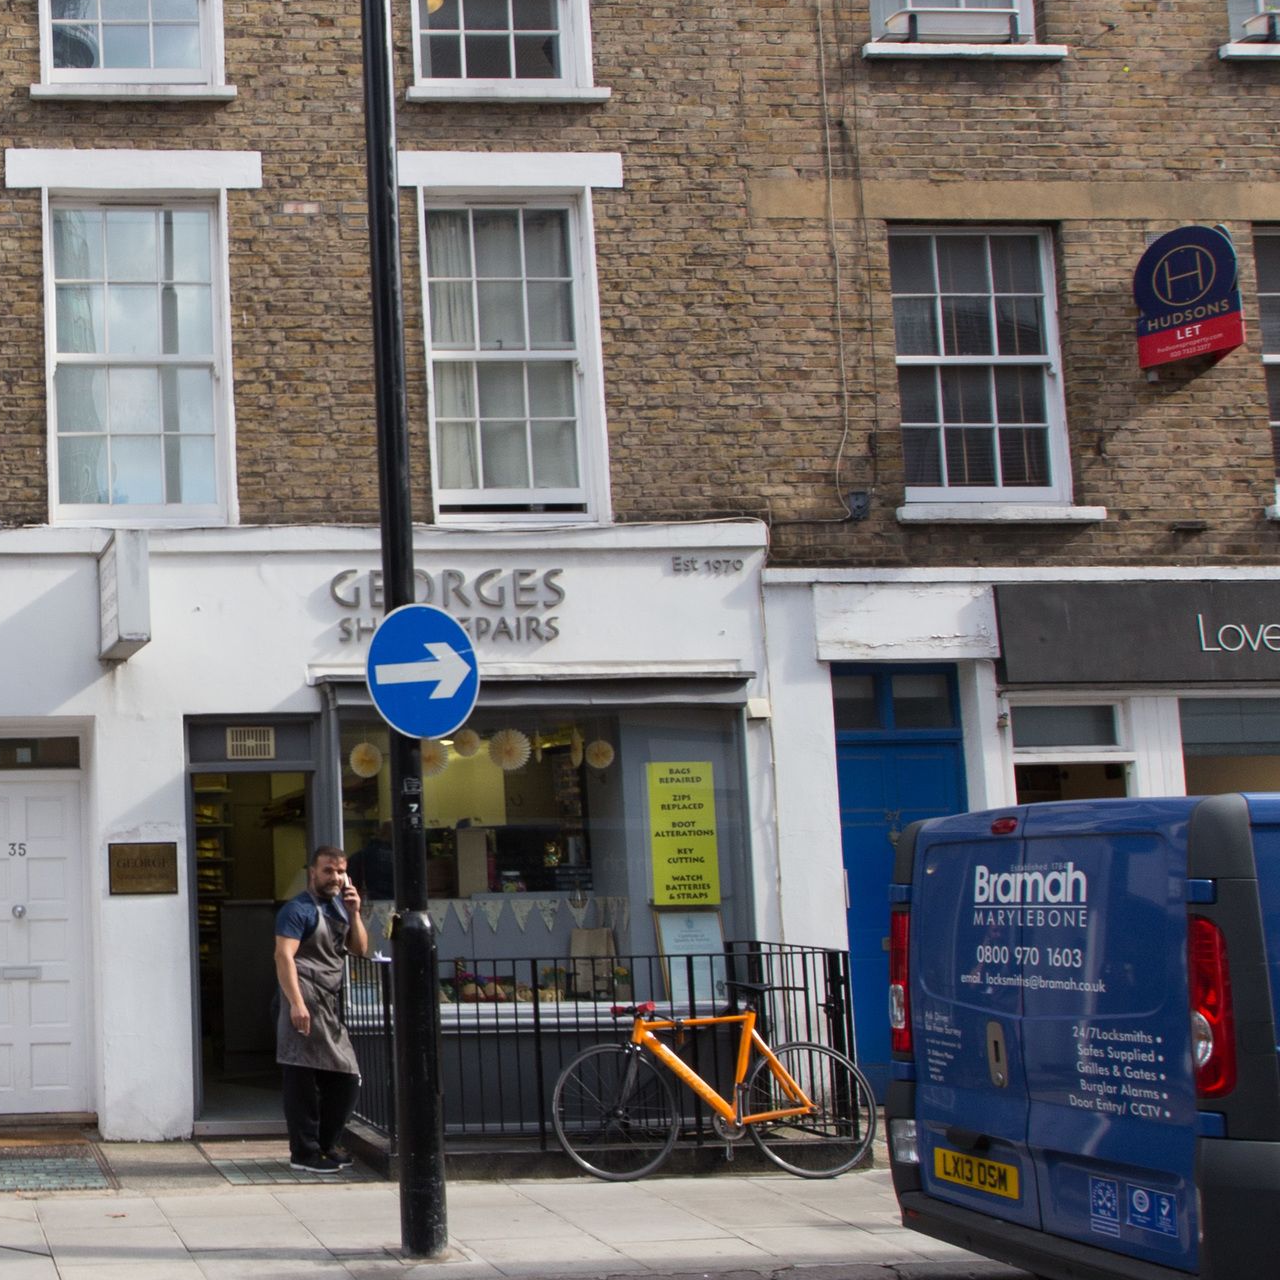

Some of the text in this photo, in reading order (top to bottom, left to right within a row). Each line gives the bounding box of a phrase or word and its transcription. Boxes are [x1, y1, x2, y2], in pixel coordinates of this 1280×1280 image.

[1147, 299, 1231, 332] HUDSONS
[1176, 324, 1202, 341] LET
[672, 556, 744, 574] Est 1970
[659, 776, 702, 784] REPAIRED
[661, 803, 704, 811] REPLACED
[654, 830, 714, 838] ALTERATIONS
[8, 842, 26, 856] 35
[665, 883, 711, 891] BATTERIES
[974, 862, 1087, 903] Bramah
[973, 910, 1087, 927] MARYLEBONE
[976, 945, 1082, 967] 0800 970 1603
[986, 973, 1106, 993] locksmiths@bramah.co.uk
[1077, 1043, 1155, 1063] Safes Supplied
[1076, 1061, 1157, 1081] Grilles & Gates
[1080, 1078, 1160, 1100] Burglar Alarms
[1069, 1094, 1094, 1108] Door
[1130, 1103, 1161, 1117] CCTV
[943, 1153, 973, 1182] LX13
